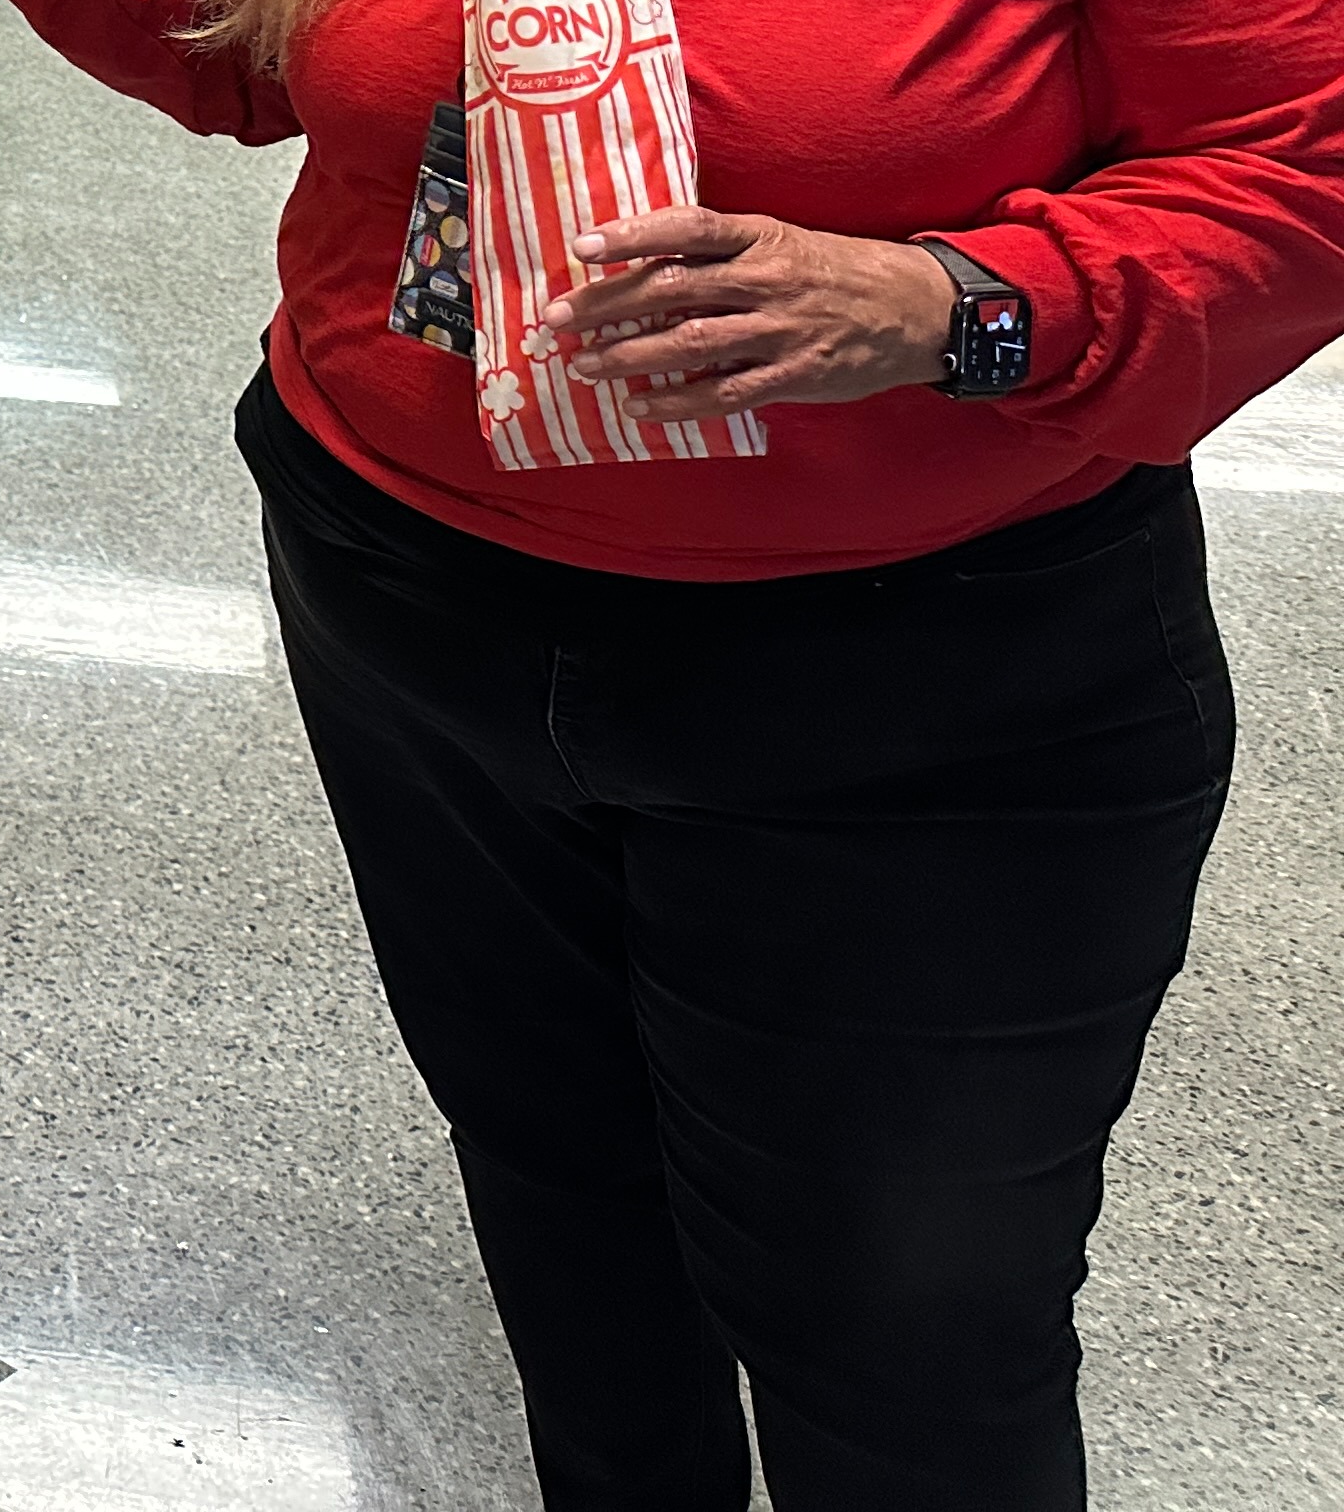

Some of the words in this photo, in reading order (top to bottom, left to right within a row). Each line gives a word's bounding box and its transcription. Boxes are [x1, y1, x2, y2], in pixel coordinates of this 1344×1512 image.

[486, 3, 604, 52] CORN
[512, 79, 533, 89] Hot
[555, 72, 590, 87] Fresh
